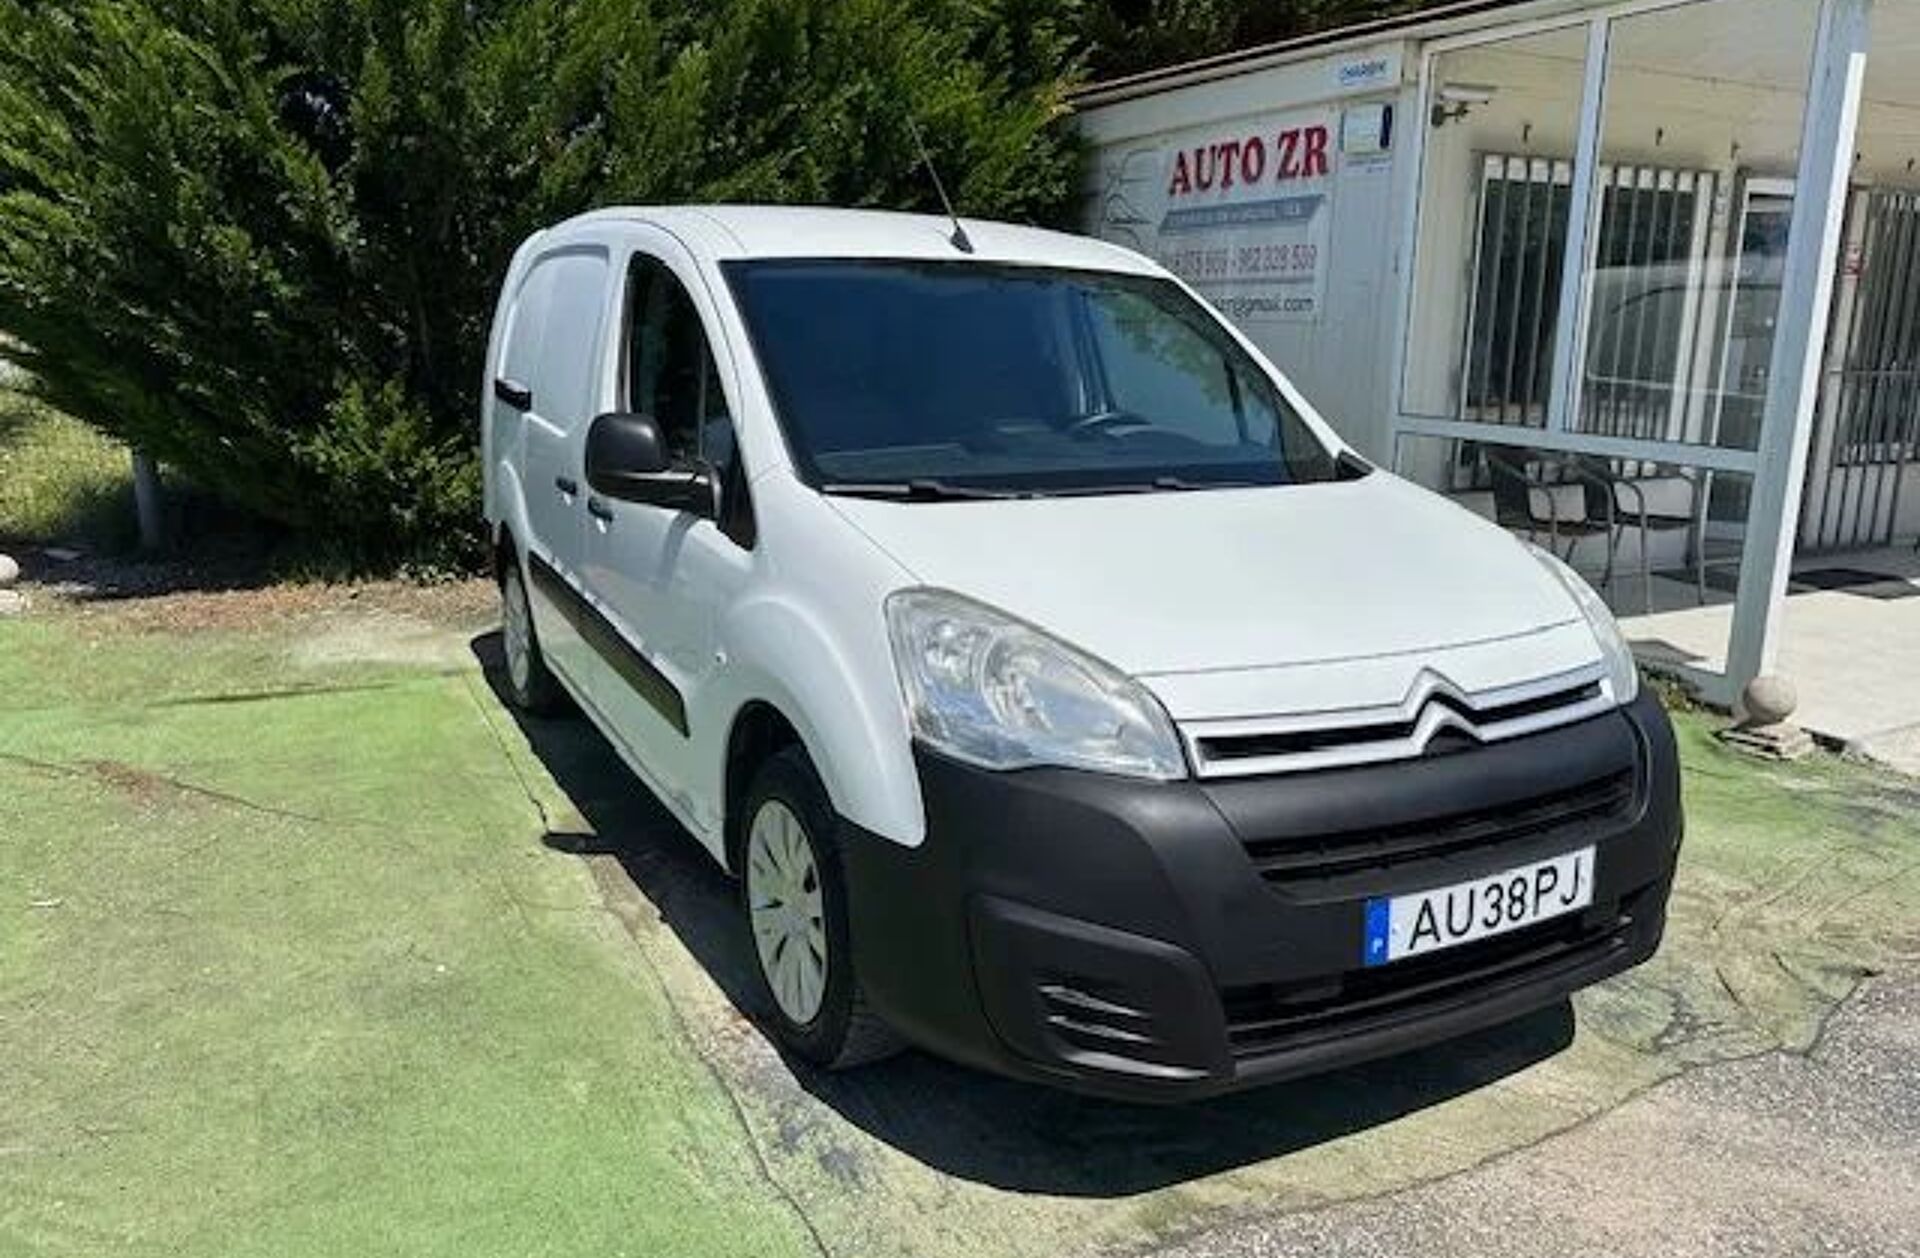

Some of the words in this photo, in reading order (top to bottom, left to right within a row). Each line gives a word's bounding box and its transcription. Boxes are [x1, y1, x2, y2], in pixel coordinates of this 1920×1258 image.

[1168, 136, 1265, 195] AUTO
[1277, 125, 1328, 181] ZR
[1408, 856, 1582, 951] AU38PJ
